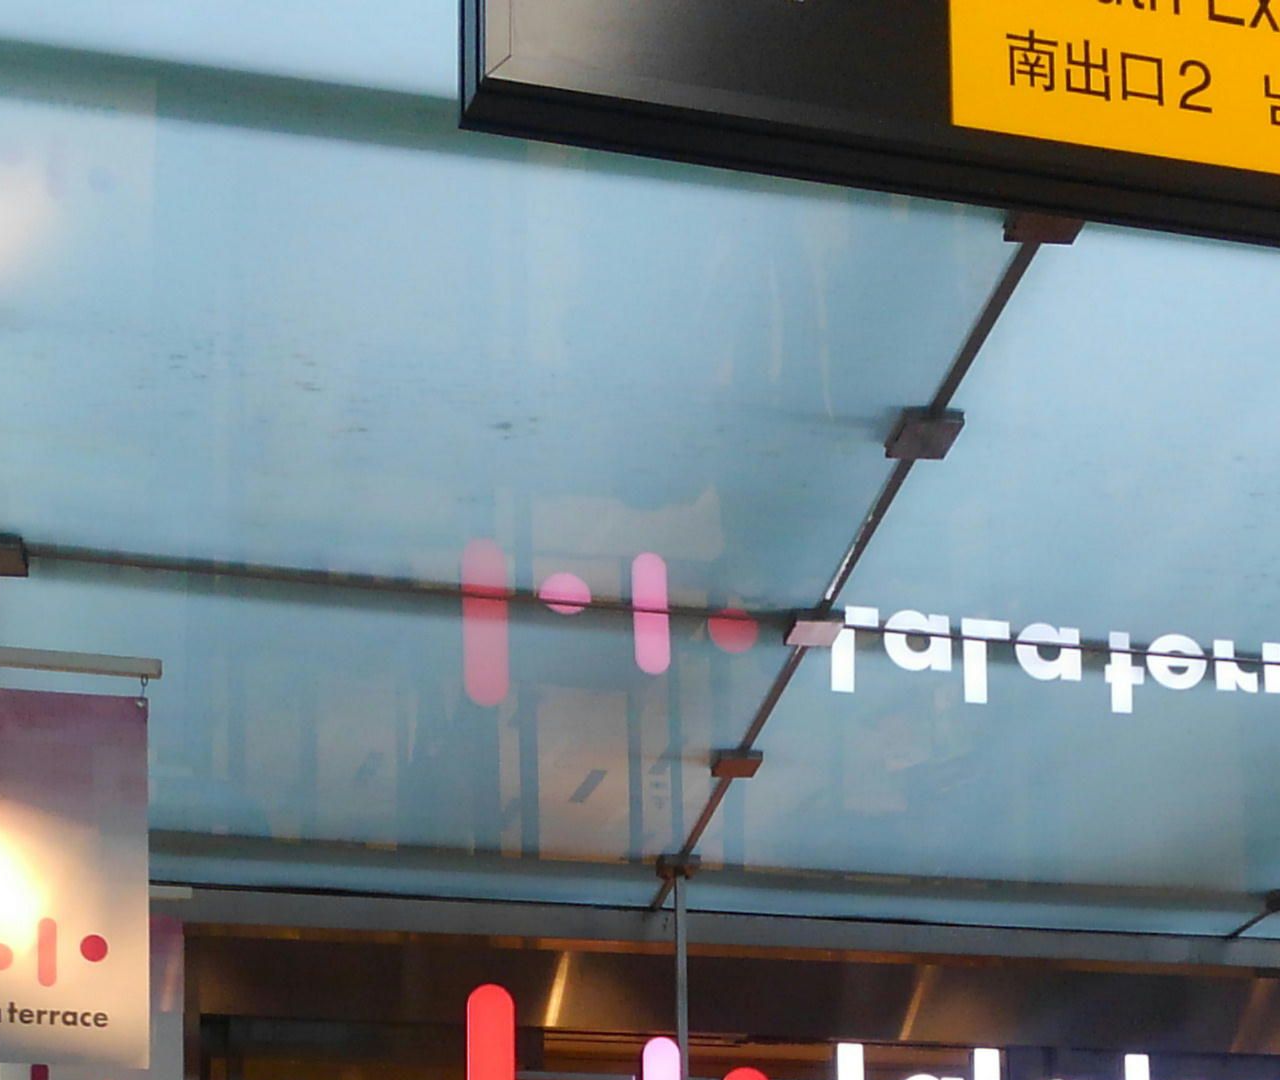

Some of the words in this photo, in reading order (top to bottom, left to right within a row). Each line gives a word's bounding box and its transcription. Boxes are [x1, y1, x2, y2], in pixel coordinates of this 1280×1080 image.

[1006, 28, 1213, 114] 南出口2
[8, 1002, 109, 1028] terrace
